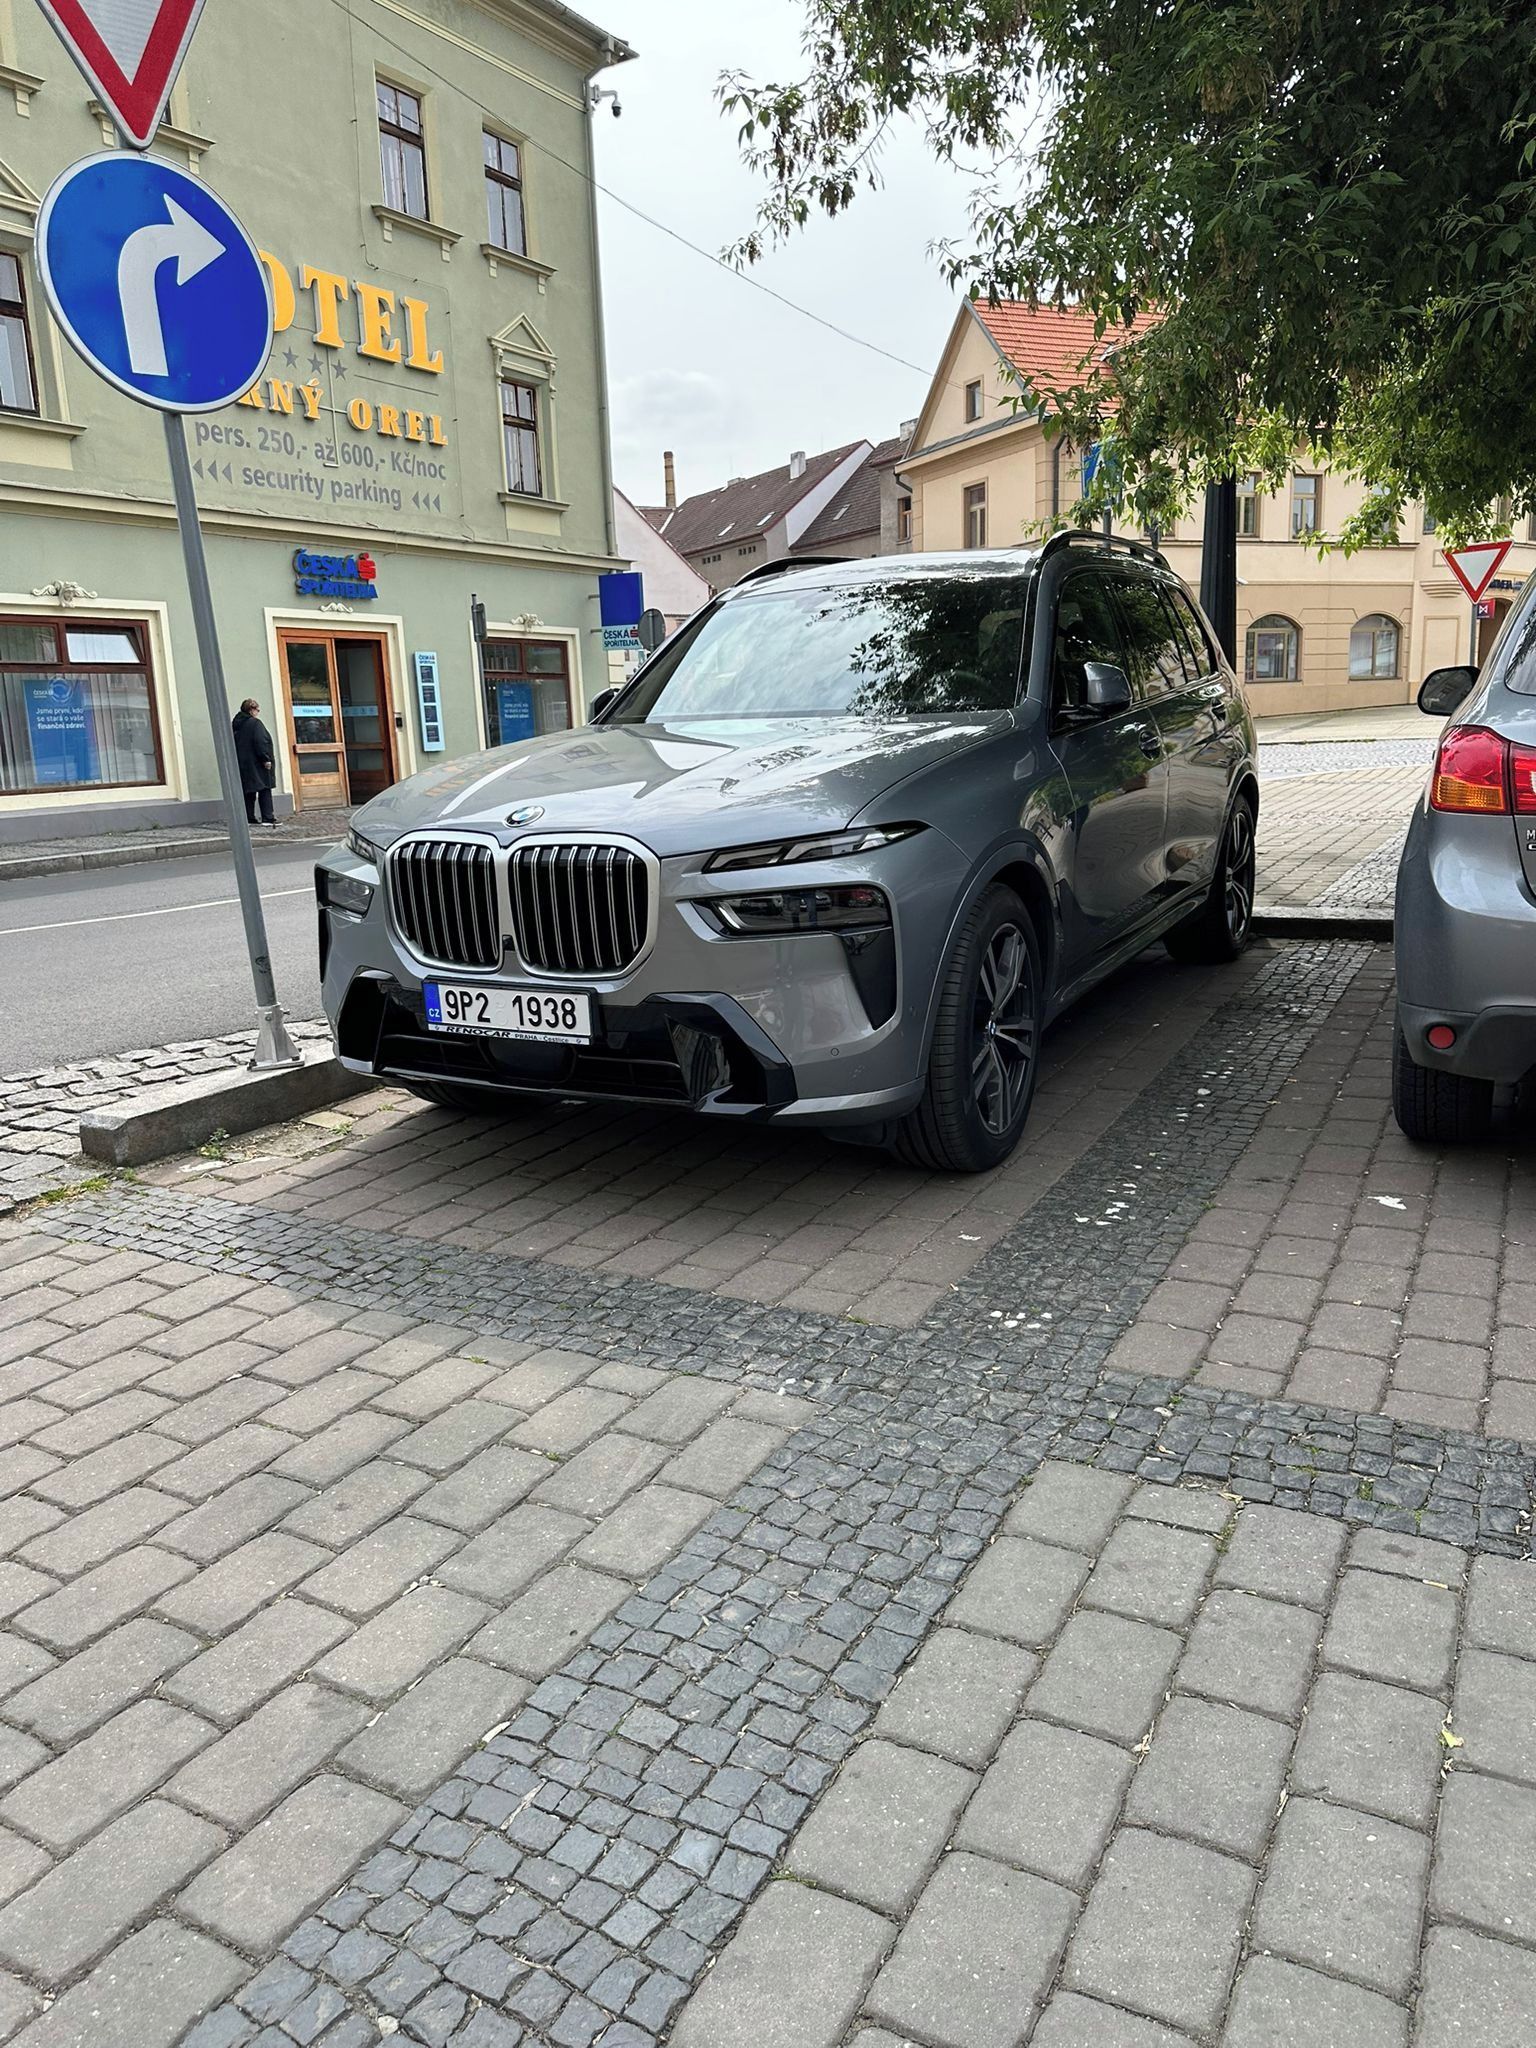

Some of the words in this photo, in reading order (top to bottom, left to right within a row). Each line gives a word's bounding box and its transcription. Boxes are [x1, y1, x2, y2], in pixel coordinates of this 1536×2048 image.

[258, 249, 444, 374] OTEL
[347, 398, 449, 446] OREL
[195, 421, 251, 449] pers.
[257, 426, 307, 455] 250,-
[314, 438, 337, 463] až
[340, 442, 385, 470] 600,-
[390, 452, 446, 482] Kč/noc
[242, 465, 324, 503] security
[330, 480, 401, 511] parking
[293, 548, 358, 579] ČESKÁ
[604, 629, 630, 639] ČESKÁ
[429, 1008, 440, 1018] CZ
[445, 990, 491, 1023] 9P2
[512, 995, 577, 1030] 1938
[446, 1027, 511, 1038] RENOCAR
[514, 1033, 538, 1041] PRAHA
